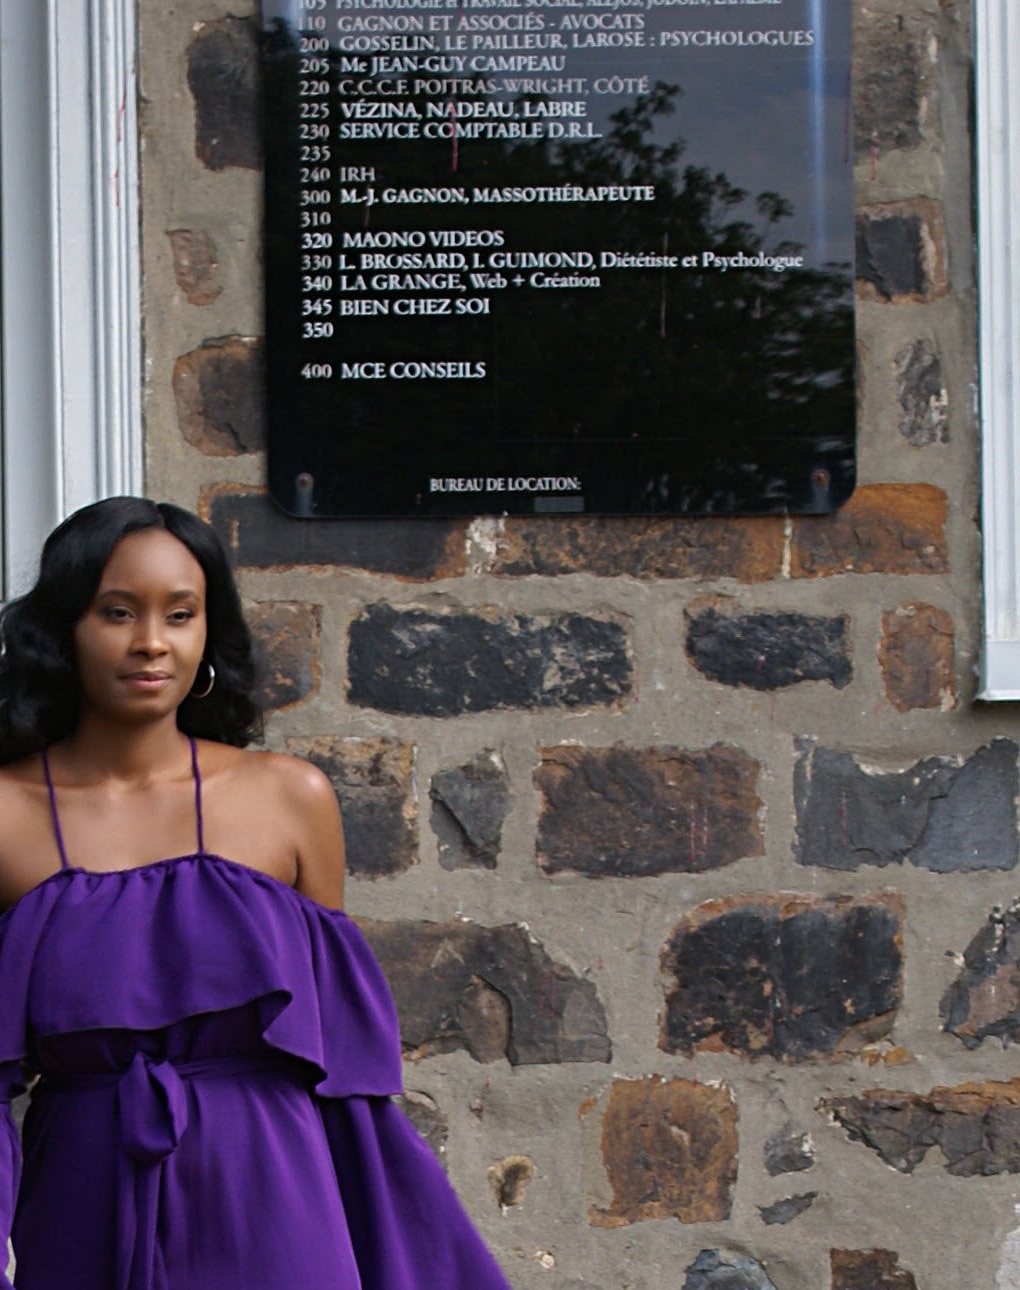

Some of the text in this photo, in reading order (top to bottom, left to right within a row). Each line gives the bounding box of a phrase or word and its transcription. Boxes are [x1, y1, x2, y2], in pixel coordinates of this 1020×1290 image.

[298, 16, 326, 31] 110
[338, 15, 424, 31] GAGNON
[430, 16, 454, 31] ET
[457, 12, 545, 31] ASSOCIÉS
[560, 14, 645, 29] AVOCATS
[299, 38, 329, 51] 200
[340, 35, 440, 51] GOSSELIN,
[445, 35, 466, 50] LE
[472, 33, 567, 50] PAILLEUR,
[573, 32, 645, 48] LAROSE
[660, 30, 814, 46] PSYCHOLOGUES
[299, 59, 330, 74] 205
[371, 56, 467, 76] JEAN-GUY
[470, 55, 566, 72] CAMPEAU
[299, 81, 330, 95] 220
[594, 75, 650, 94] CÔTÉ
[300, 99, 587, 120] 225 VÉZINA, NADEAU, LABRE
[300, 122, 603, 139] 230 SERVICE COMPTABLE D.R.L.
[300, 146, 330, 161] 235
[300, 167, 376, 182] 240 IRH
[300, 190, 330, 206] 300
[383, 187, 469, 204] GAGNON,
[473, 183, 655, 203] MASSOTHÉRAPEUTE
[300, 212, 331, 226] 310
[301, 230, 505, 249] 320 MAONO VIDEOS
[301, 255, 332, 271] 330
[339, 254, 356, 270] L.
[361, 253, 469, 271] BROSSARD,
[489, 252, 596, 270] GUIMOND,
[600, 251, 678, 268] Diététiste
[682, 254, 698, 268] et
[702, 251, 804, 272] Psychologue
[301, 276, 332, 292] 340
[340, 275, 367, 291] LA
[371, 274, 467, 292] GRANGE,
[470, 273, 507, 289] Web
[530, 271, 601, 289] Création
[301, 298, 490, 316] 345 BIEN CHEZ SOI
[302, 323, 334, 339] 350
[301, 362, 487, 379] 400 MCE CONSEILS
[430, 478, 484, 492] BUREAU
[486, 477, 506, 491] DE
